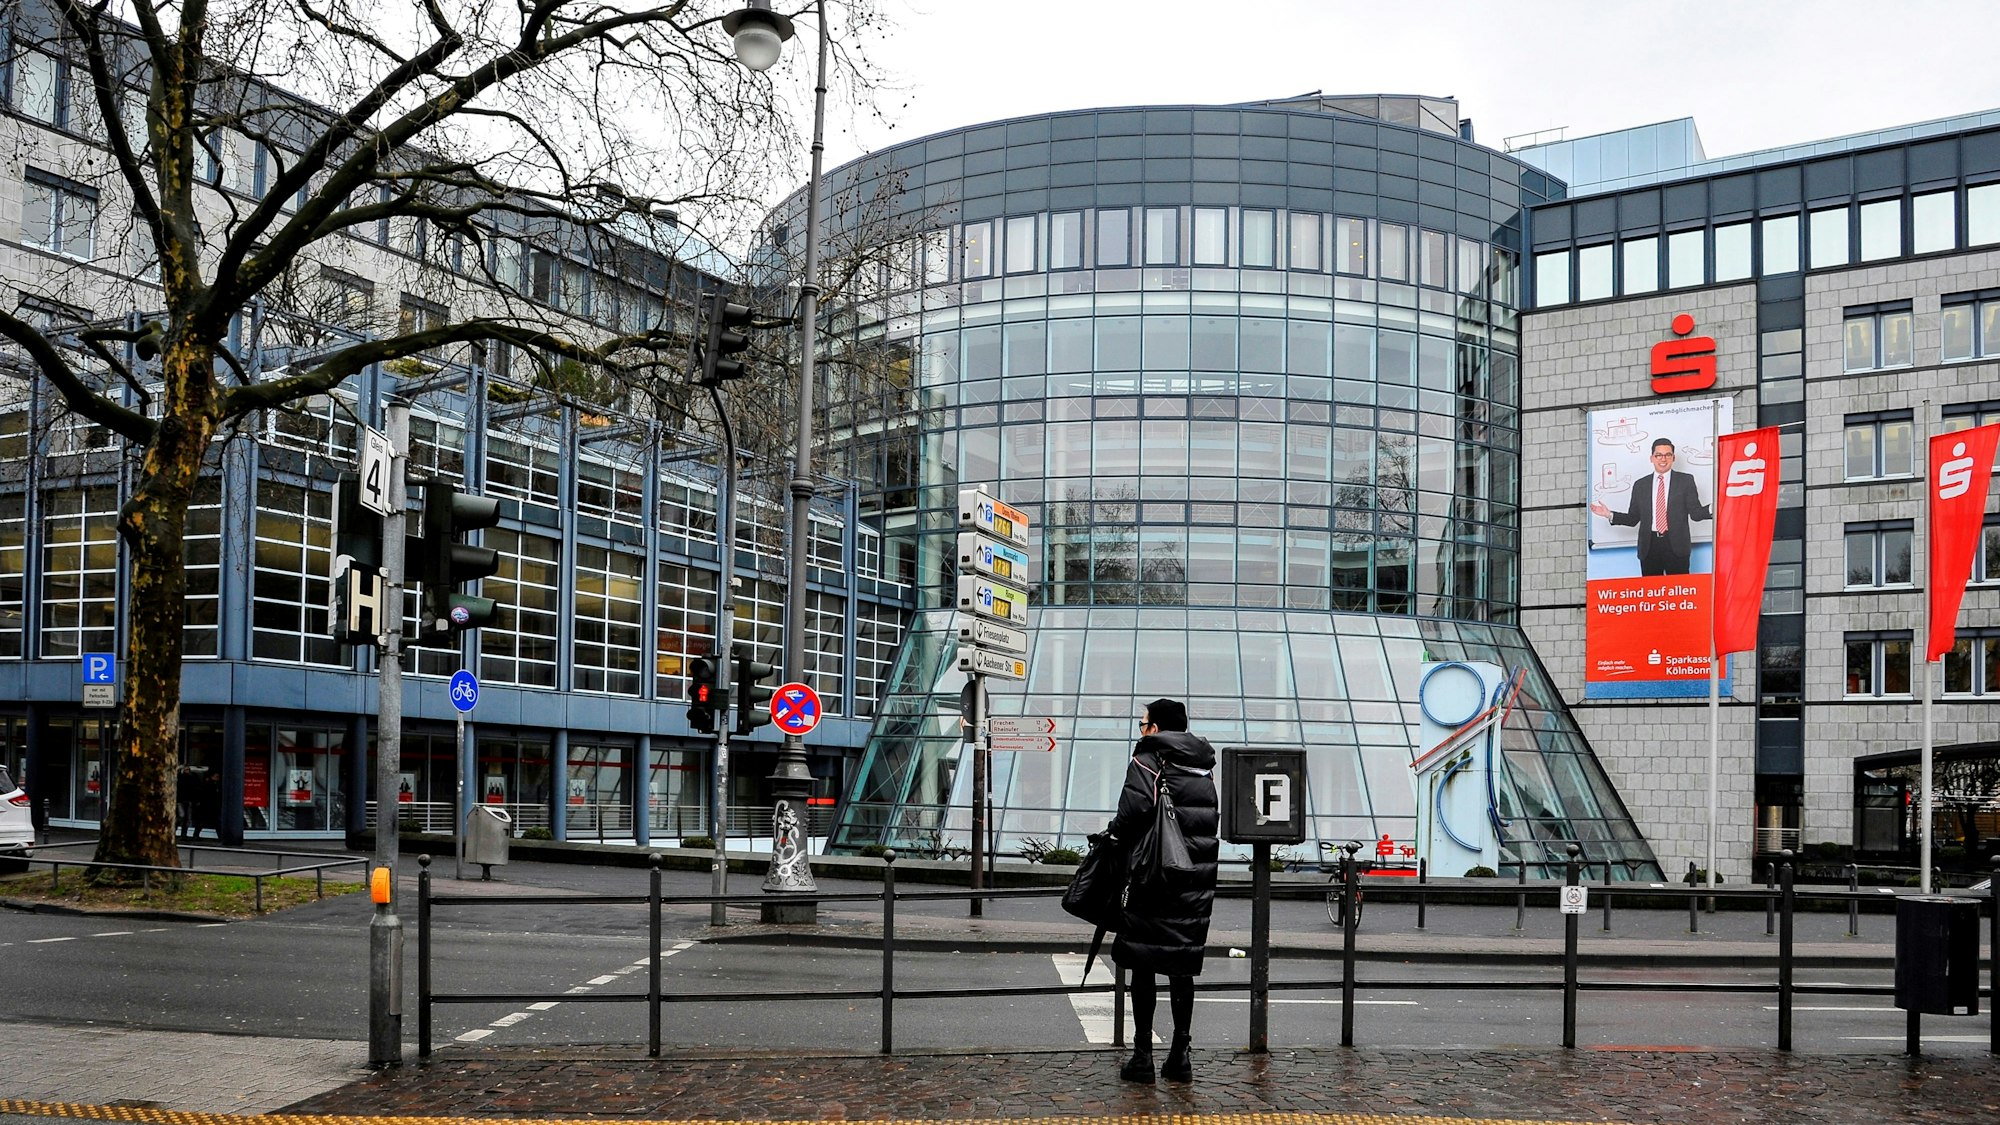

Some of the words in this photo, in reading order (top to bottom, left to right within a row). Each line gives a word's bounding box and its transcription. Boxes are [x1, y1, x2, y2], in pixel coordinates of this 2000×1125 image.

[366, 458, 381, 504] 4
[1598, 589, 1617, 600] Wir
[1620, 588, 1644, 599] sind
[1647, 586, 1667, 597] auf
[1668, 585, 1697, 596] allen
[350, 569, 381, 636] H
[1598, 603, 1636, 615] Wegen
[1639, 601, 1656, 612] für
[1658, 600, 1676, 611] Sie
[1680, 599, 1698, 610] da.
[984, 625, 1009, 644] Friesenplatz
[984, 656, 1004, 671] Aachener
[1262, 780, 1283, 816] F
